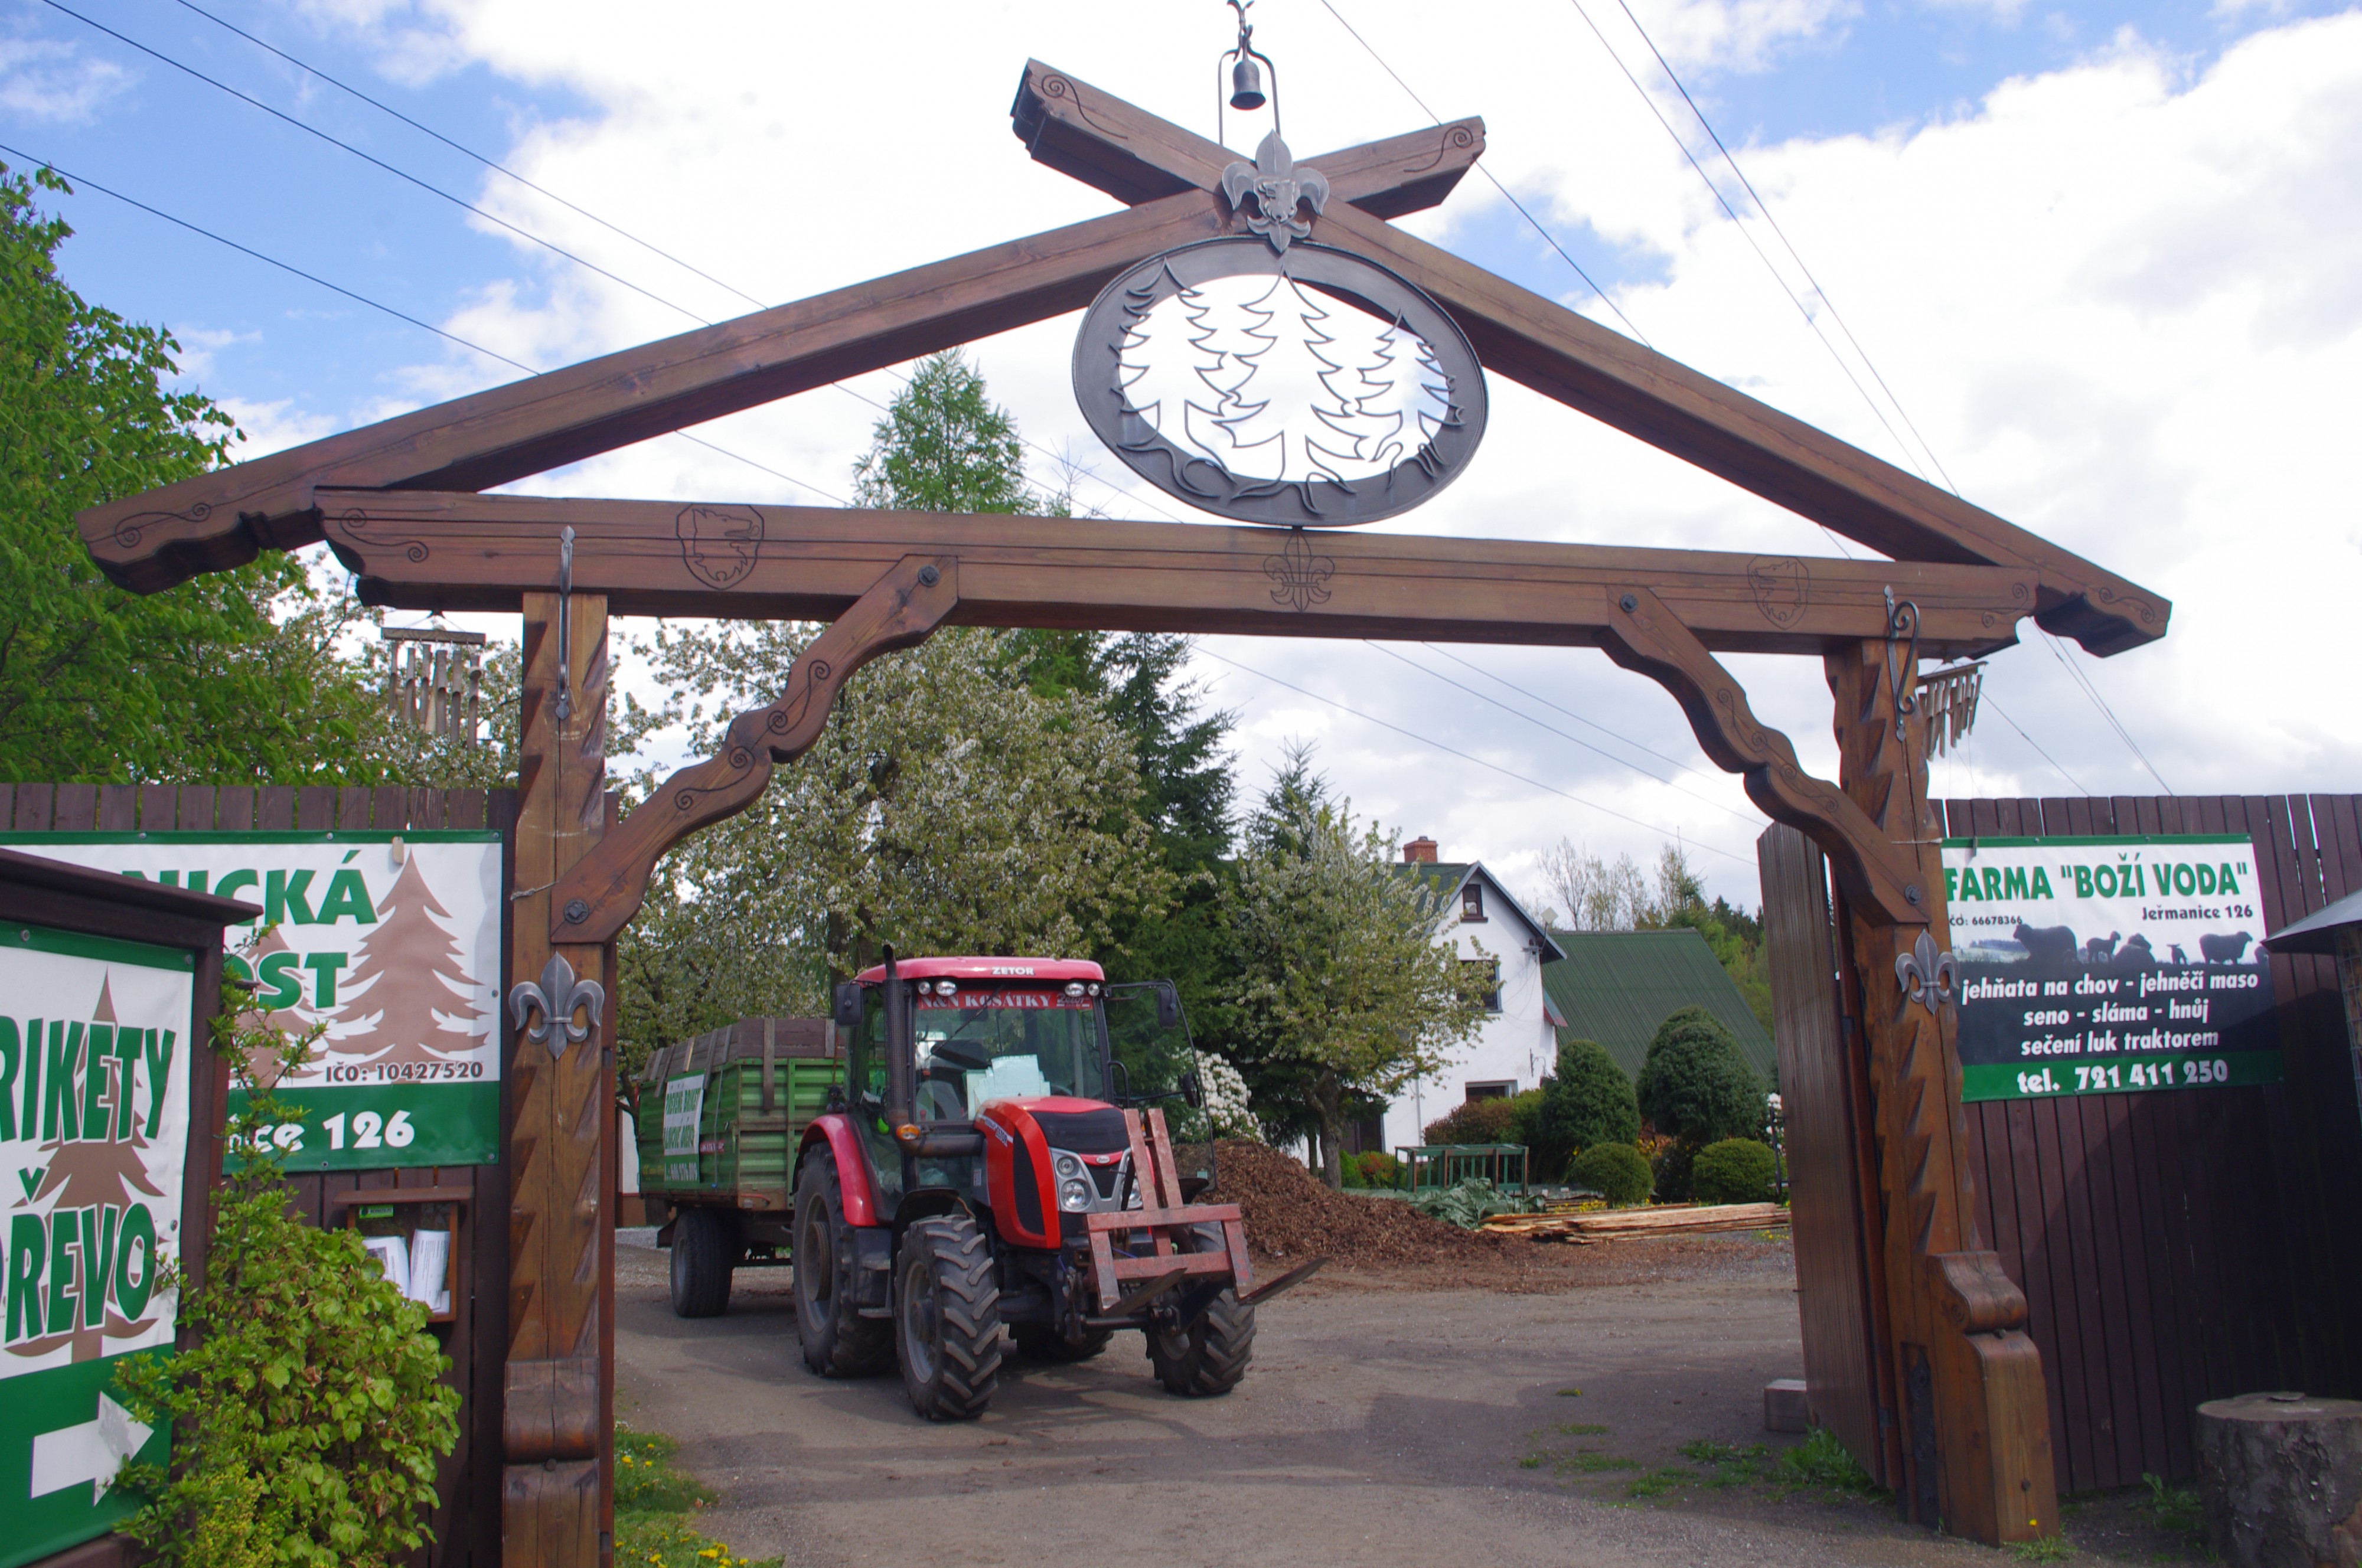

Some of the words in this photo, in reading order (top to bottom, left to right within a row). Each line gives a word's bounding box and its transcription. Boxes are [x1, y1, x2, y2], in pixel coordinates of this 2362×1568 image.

[1943, 865, 2054, 901] FARMA
[2060, 852, 2146, 899] "BOŽÍ
[2151, 862, 2247, 897] VODA"
[1972, 916, 2023, 926] 66678366
[2142, 904, 2221, 921] Jeřmanice
[2225, 904, 2253, 919] 126
[991, 966, 1036, 975] ZETOR
[920, 995, 959, 1008] N&N
[964, 992, 1051, 1007] KOSÁTKY
[1962, 976, 2038, 1005] jehňata
[2044, 981, 2068, 996] na
[2074, 973, 2119, 995] chov
[2139, 970, 2204, 998] jehněčí
[2210, 974, 2259, 989] maso
[2023, 1010, 2070, 1026] seno
[2092, 1001, 2148, 1023] sláma
[2168, 997, 2210, 1024] hnůj
[2021, 1033, 2082, 1056] sečení
[2087, 1030, 2118, 1053] luk
[2124, 1027, 2219, 1050] traktorem
[325, 1061, 368, 1083] IČO:
[377, 1061, 484, 1081] 10427520
[2017, 1067, 2061, 1093] tel.
[2074, 1064, 2121, 1091] 721
[2129, 1061, 2174, 1086] 411
[2182, 1059, 2229, 1084] 250
[322, 1109, 415, 1150] 126
